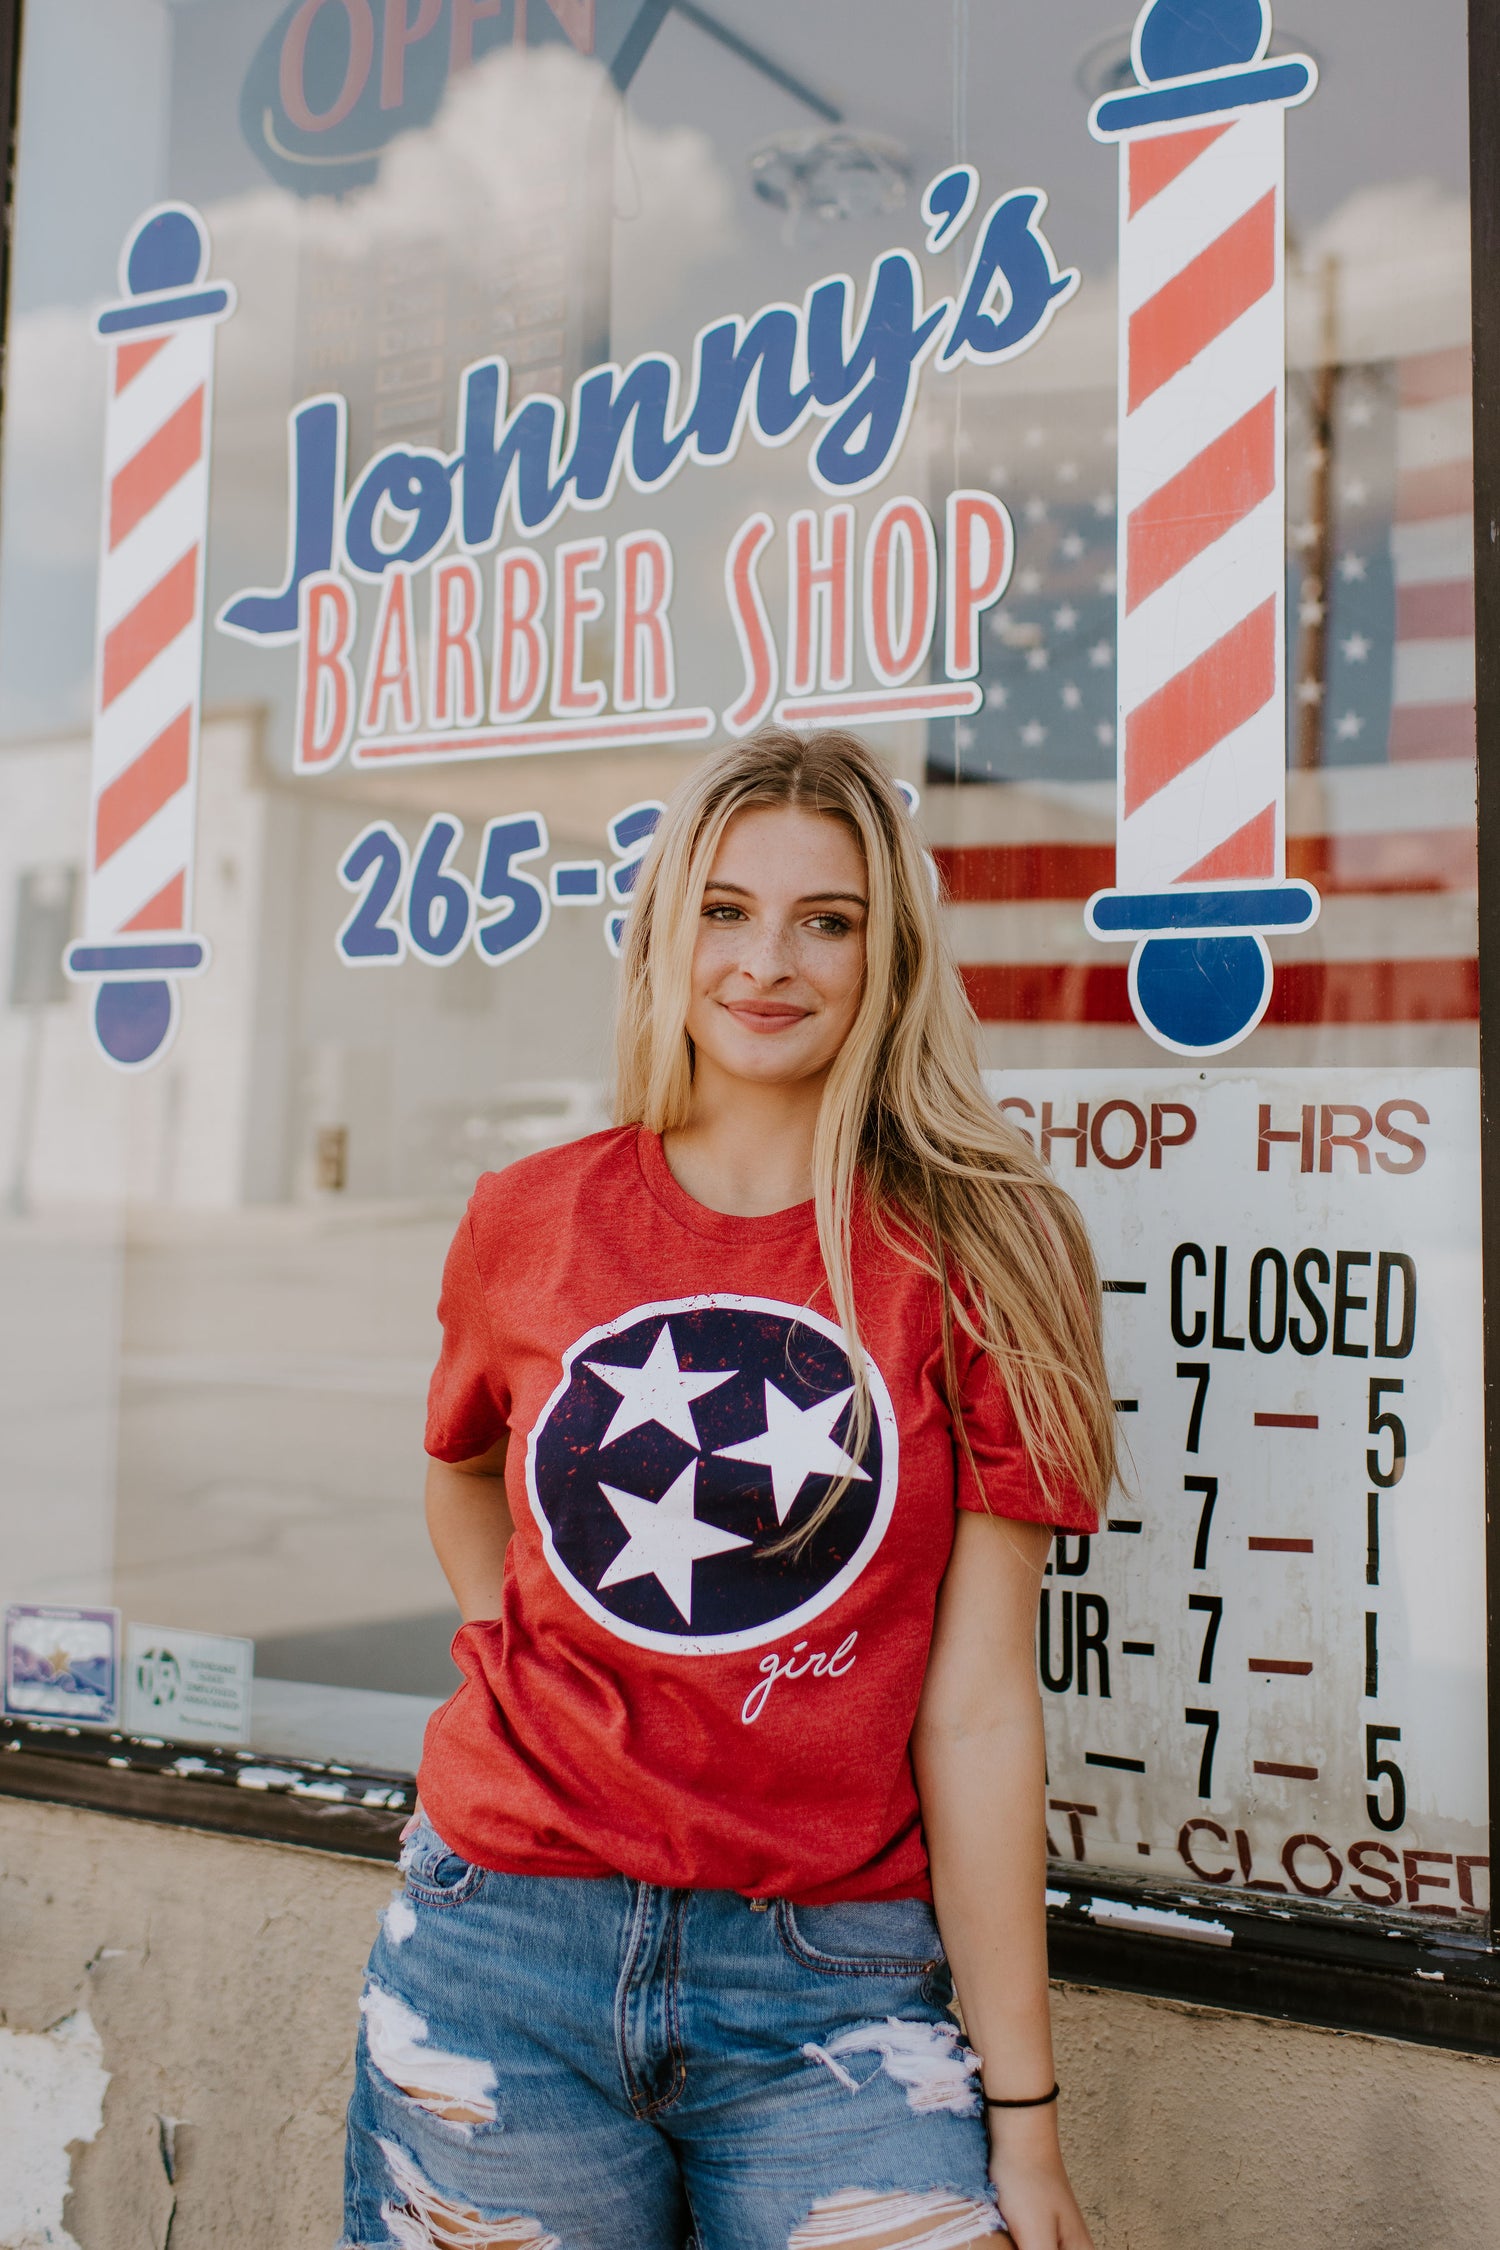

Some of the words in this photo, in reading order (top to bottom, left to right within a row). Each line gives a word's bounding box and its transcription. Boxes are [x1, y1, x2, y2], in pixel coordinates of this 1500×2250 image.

[215, 164, 1080, 638] Johnny's
[293, 529, 675, 775] BARBER
[722, 490, 1014, 735] SHOP
[1257, 1098, 1431, 1175] HRS
[1170, 1242, 1416, 1359] CLOSED
[1176, 1363, 1210, 1453] 7
[1366, 1378, 1407, 1487] 5
[1184, 1475, 1218, 1569] 7
[741, 1630, 858, 1725] girl
[1188, 1595, 1223, 1684] 7
[1185, 1708, 1219, 1798] 7
[1366, 1724, 1406, 1831] 5
